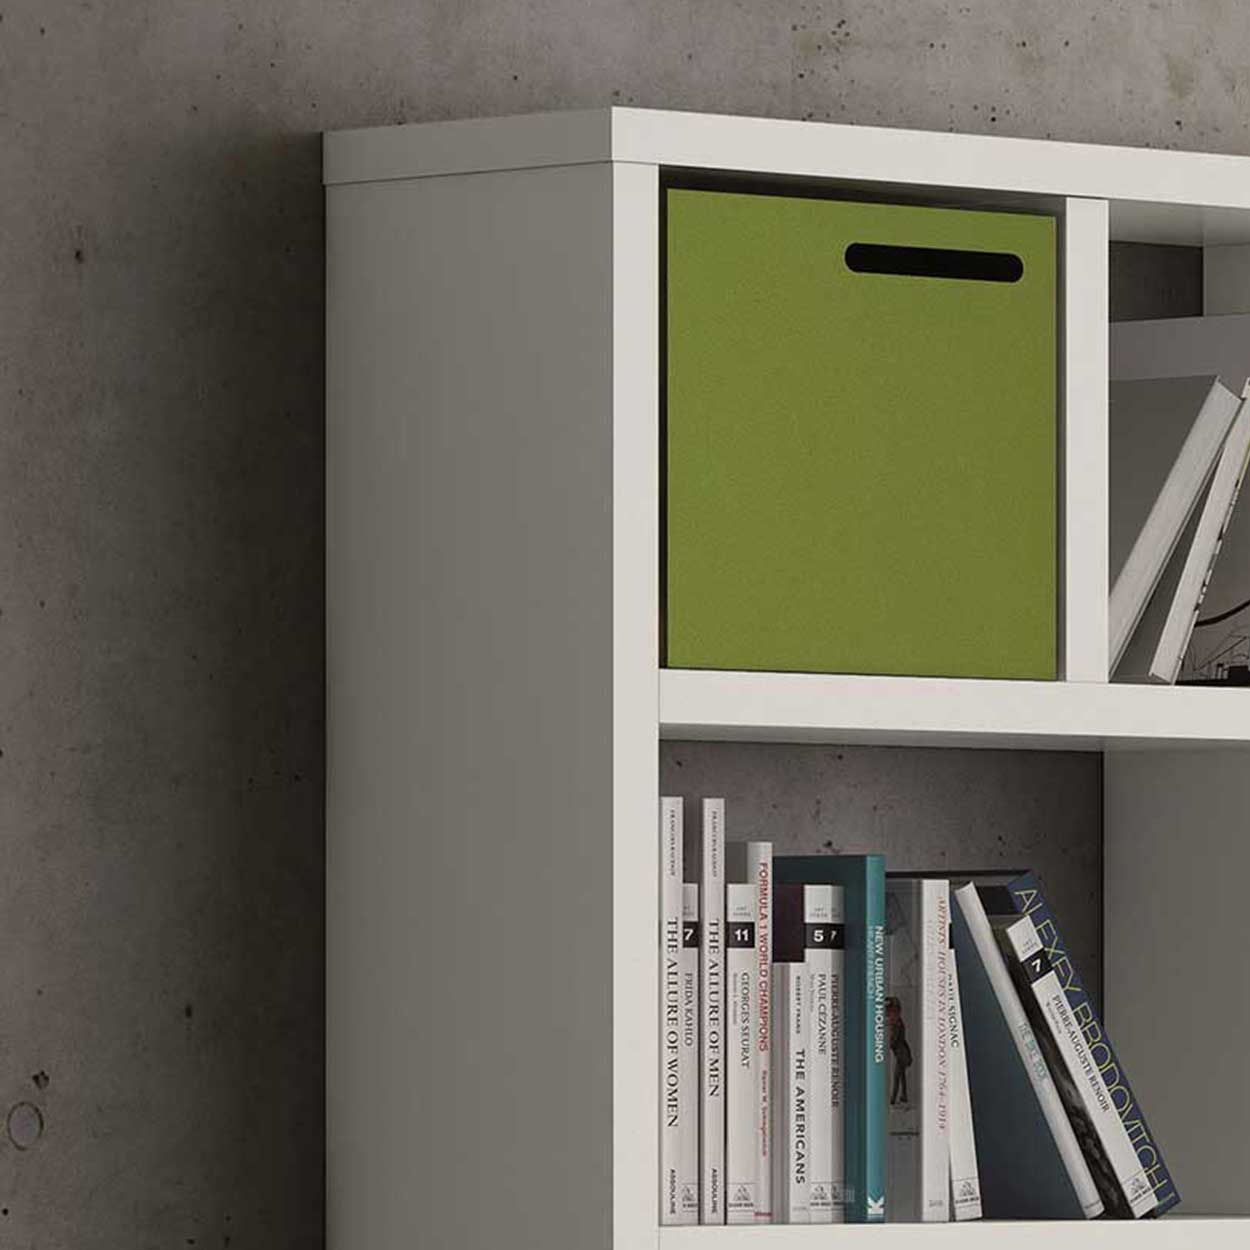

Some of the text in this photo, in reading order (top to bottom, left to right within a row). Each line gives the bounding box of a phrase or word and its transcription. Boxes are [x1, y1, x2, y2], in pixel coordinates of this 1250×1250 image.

[759, 862, 768, 922] FORMULA
[685, 928, 694, 941] 7
[735, 928, 749, 941] 11
[759, 930, 768, 978] WORLD
[813, 929, 824, 942] 5
[1031, 958, 1041, 972] 7
[667, 917, 678, 1128] THE ALLURE OF WOMEN
[685, 972, 693, 1046] FRIDA KAHLO
[709, 918, 719, 1097] THE ALLURE OF MEN
[741, 972, 750, 1067] GEORGES SEURAT
[759, 980, 768, 1052] CHAMPIONS
[818, 974, 826, 1000] PAUL
[875, 925, 884, 1063] NEW URBAN HOUSING
[948, 1004, 959, 1048] SIGNAC
[1013, 889, 1167, 1193] ALEXEY BRODOVITCH
[1052, 994, 1111, 1112] PIERRE-AUGUSTE RENOIR
[795, 1048, 805, 1185] THE AMERICANS
